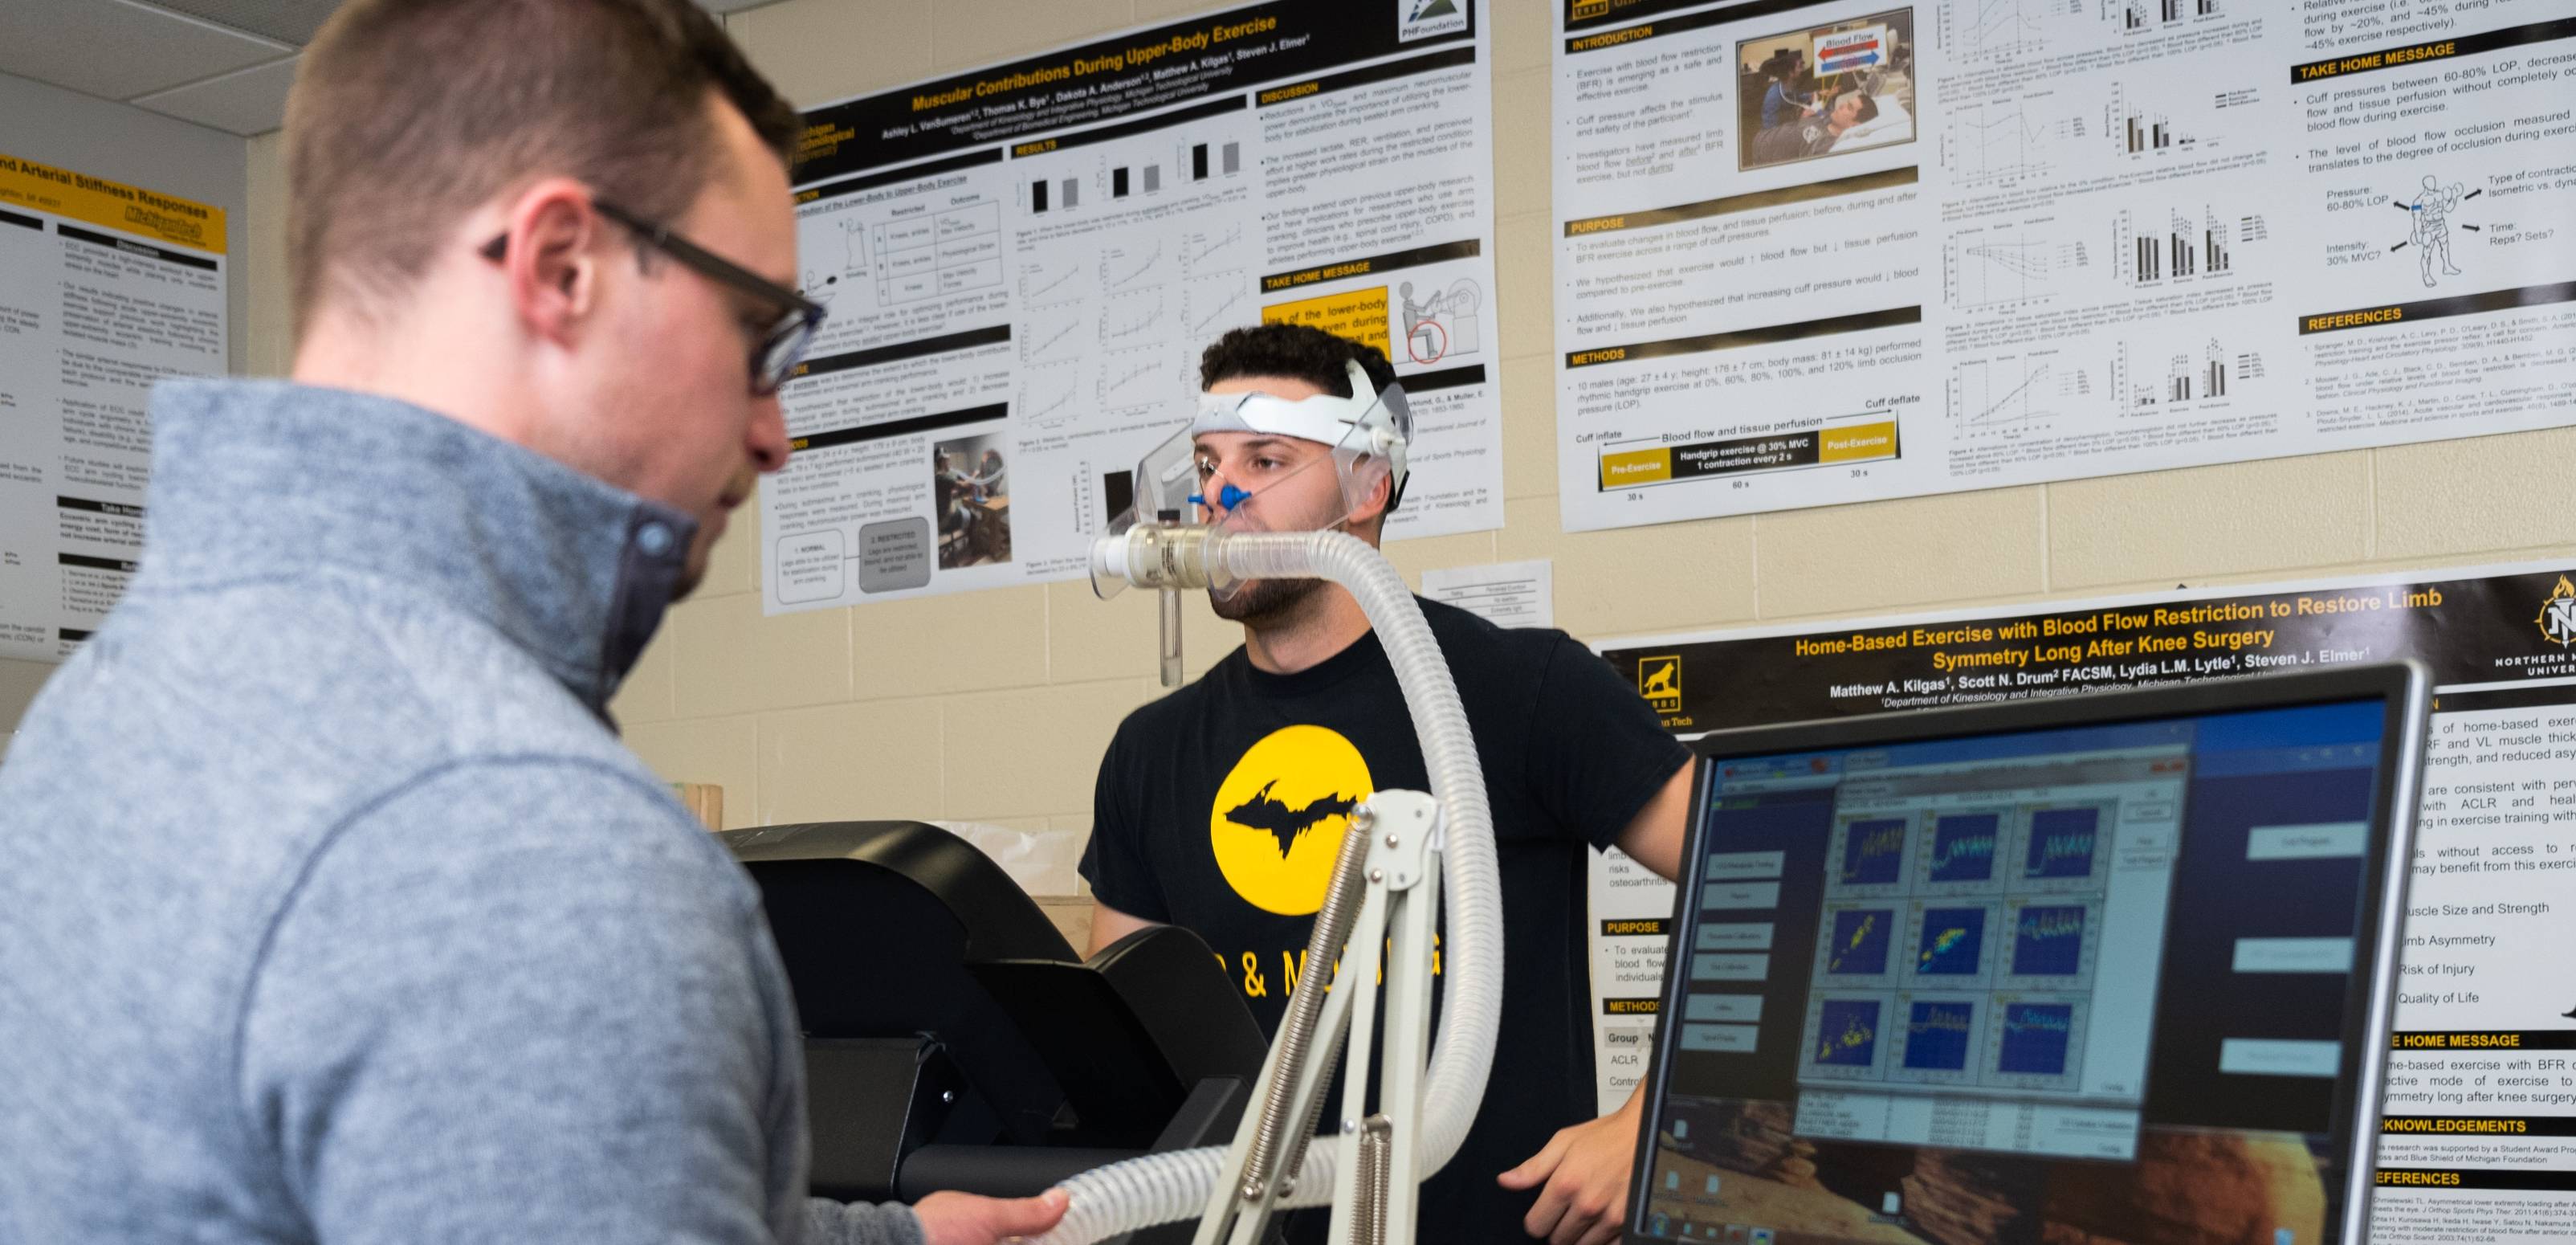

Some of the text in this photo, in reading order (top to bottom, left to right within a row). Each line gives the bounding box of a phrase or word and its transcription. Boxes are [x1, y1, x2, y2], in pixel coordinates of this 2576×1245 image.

[1572, 26, 1652, 51] INTRODUCTION
[1826, 33, 1874, 47] Blood Flow
[912, 16, 1277, 111] Muscular Contributions During Upper-Body Exercise
[1576, 44, 1722, 79] Exercise with blood flow restriction
[2300, 43, 2454, 79] TAKE HOME MESSAGE
[1262, 83, 1319, 103] DISCUSSION
[2306, 92, 2328, 104] Cuff
[2333, 84, 2386, 102] pressures
[2391, 76, 2438, 91] between
[2444, 66, 2486, 82] 60-80%
[2306, 68, 2558, 118] flow and tissue perfusion without completely
[1016, 139, 1058, 156] RESULTS
[20, 161, 71, 184] Arterial
[75, 174, 134, 201] Stiffness
[137, 190, 208, 219] Responses
[2326, 194, 2389, 212] 60-80% LOP
[1571, 217, 1624, 233] PURPOSE
[2489, 229, 2554, 246] Reps? Sets?
[2326, 250, 2381, 266] 30% MVC?
[1266, 262, 1369, 288] TAKE HOME MESSAGE
[1288, 299, 1387, 324] of the lower-body
[2309, 308, 2402, 330] REFERENCES
[1352, 315, 1387, 329] during
[1367, 329, 1388, 341] and
[1572, 349, 1624, 365] METHODS
[1865, 394, 1920, 409] Cuff deflate
[1575, 431, 1622, 443] Cuff inflate
[1661, 417, 1823, 443] Blood flow and tissue perfusion
[1680, 438, 1808, 460] Handgrip exercise @ 30% MVC
[1827, 436, 1888, 450] Post-Exercise
[1611, 462, 1661, 474] Pre-Exercise
[1703, 457, 1751, 469] contraction
[1752, 455, 1777, 464] every
[1795, 588, 2443, 656] Home-Based Exercise with Blood Flow Restriction to Restore Limb
[1933, 630, 2274, 672] Symmetry Long After Knee Surgery
[2495, 653, 2565, 667] NORTHERN
[1830, 684, 1883, 698] Matthew
[1885, 680, 1900, 694] A.
[1958, 675, 1995, 689] Scott
[1998, 673, 2012, 687] N.
[2062, 664, 2116, 682] FACSM,
[2119, 662, 2158, 680] Lydia
[2161, 659, 2191, 674] L.M.
[2244, 654, 2297, 667] Steven
[2301, 651, 2313, 663] J.
[1609, 864, 1629, 874] risks
[2410, 859, 2536, 876] may benefit from this
[2442, 901, 2550, 916] Size and Strength
[1608, 921, 1659, 933] PURPOSE
[2428, 934, 2496, 948] Asymmetry
[2398, 963, 2475, 977] Risk of Injury
[2397, 991, 2480, 1006] Quality of Life
[1608, 1033, 1639, 1044] Group
[2404, 1035, 2519, 1047] HOME MESSAGE
[1611, 1055, 1638, 1065] ACLR
[2450, 1059, 2565, 1070] exercise with BFR
[2410, 1153, 2427, 1161] Blue
[2429, 1153, 2454, 1162] Shield
[2455, 1154, 2464, 1162] of
[2465, 1154, 2501, 1164] Michigan
[2502, 1155, 2547, 1164] Foundation
